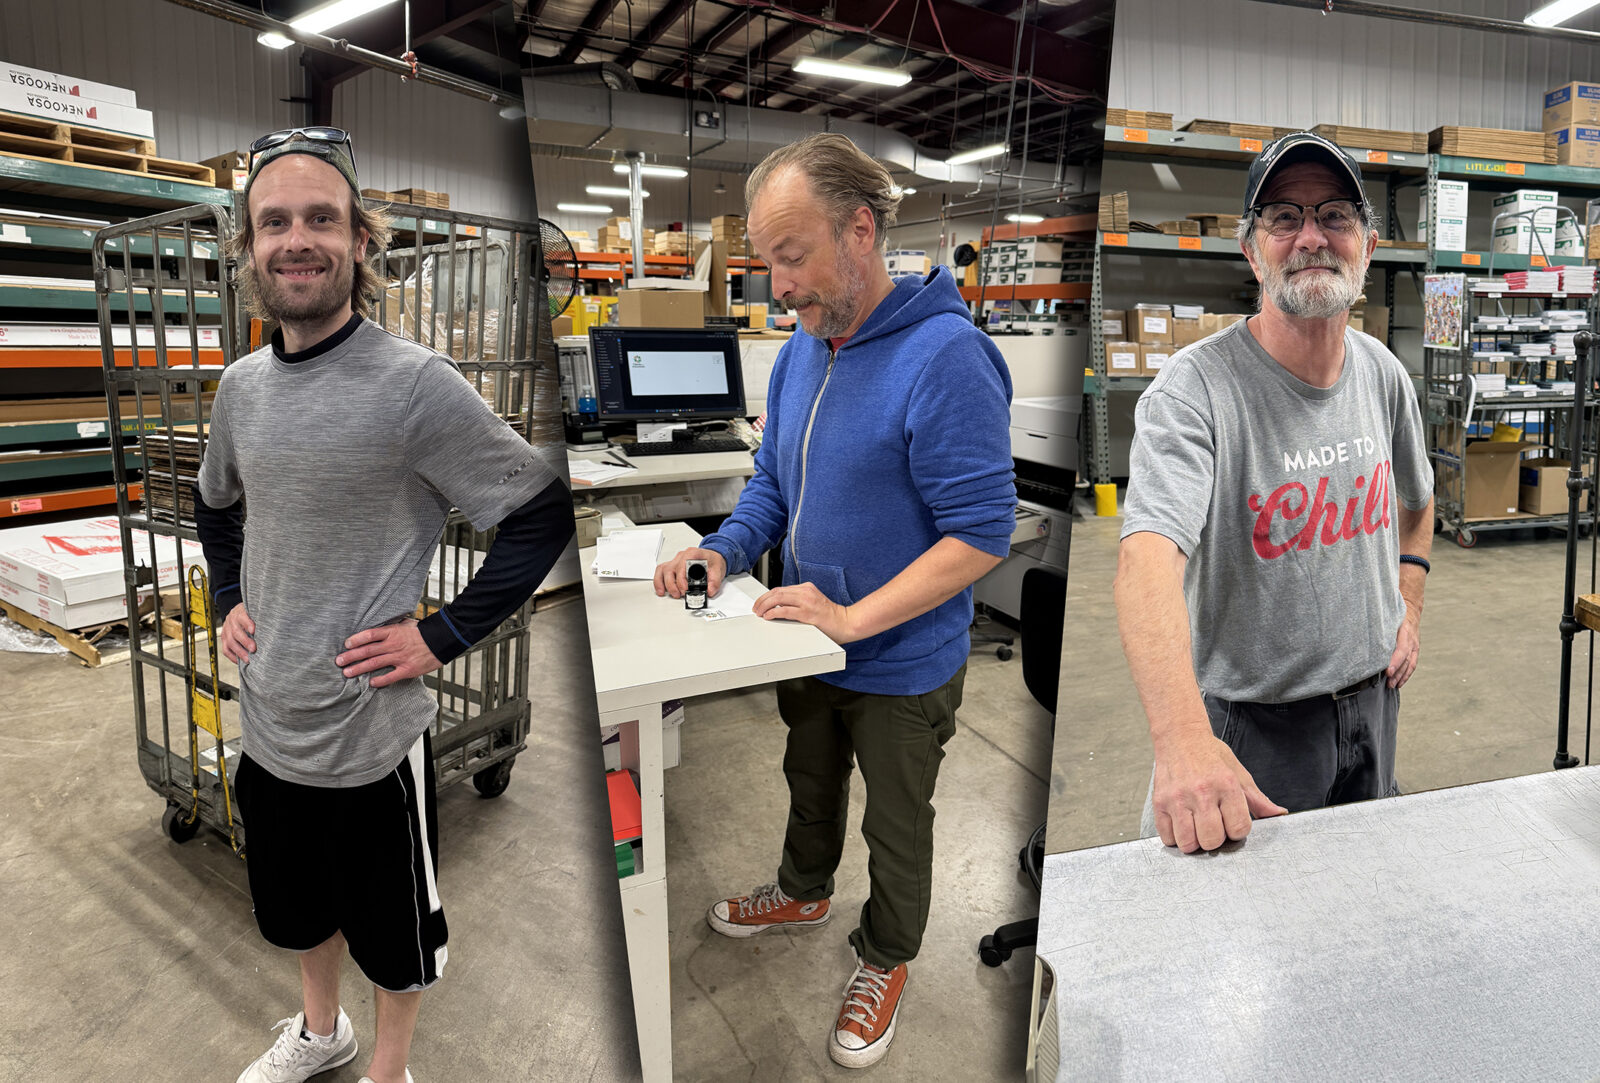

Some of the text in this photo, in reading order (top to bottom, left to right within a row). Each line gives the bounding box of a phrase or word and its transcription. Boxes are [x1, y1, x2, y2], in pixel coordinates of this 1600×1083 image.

[9, 73, 67, 93] NEKOOSA
[27, 96, 84, 116] NEKOOSA
[1284, 435, 1374, 472] MADE TO
[1248, 459, 1391, 560] Chill
